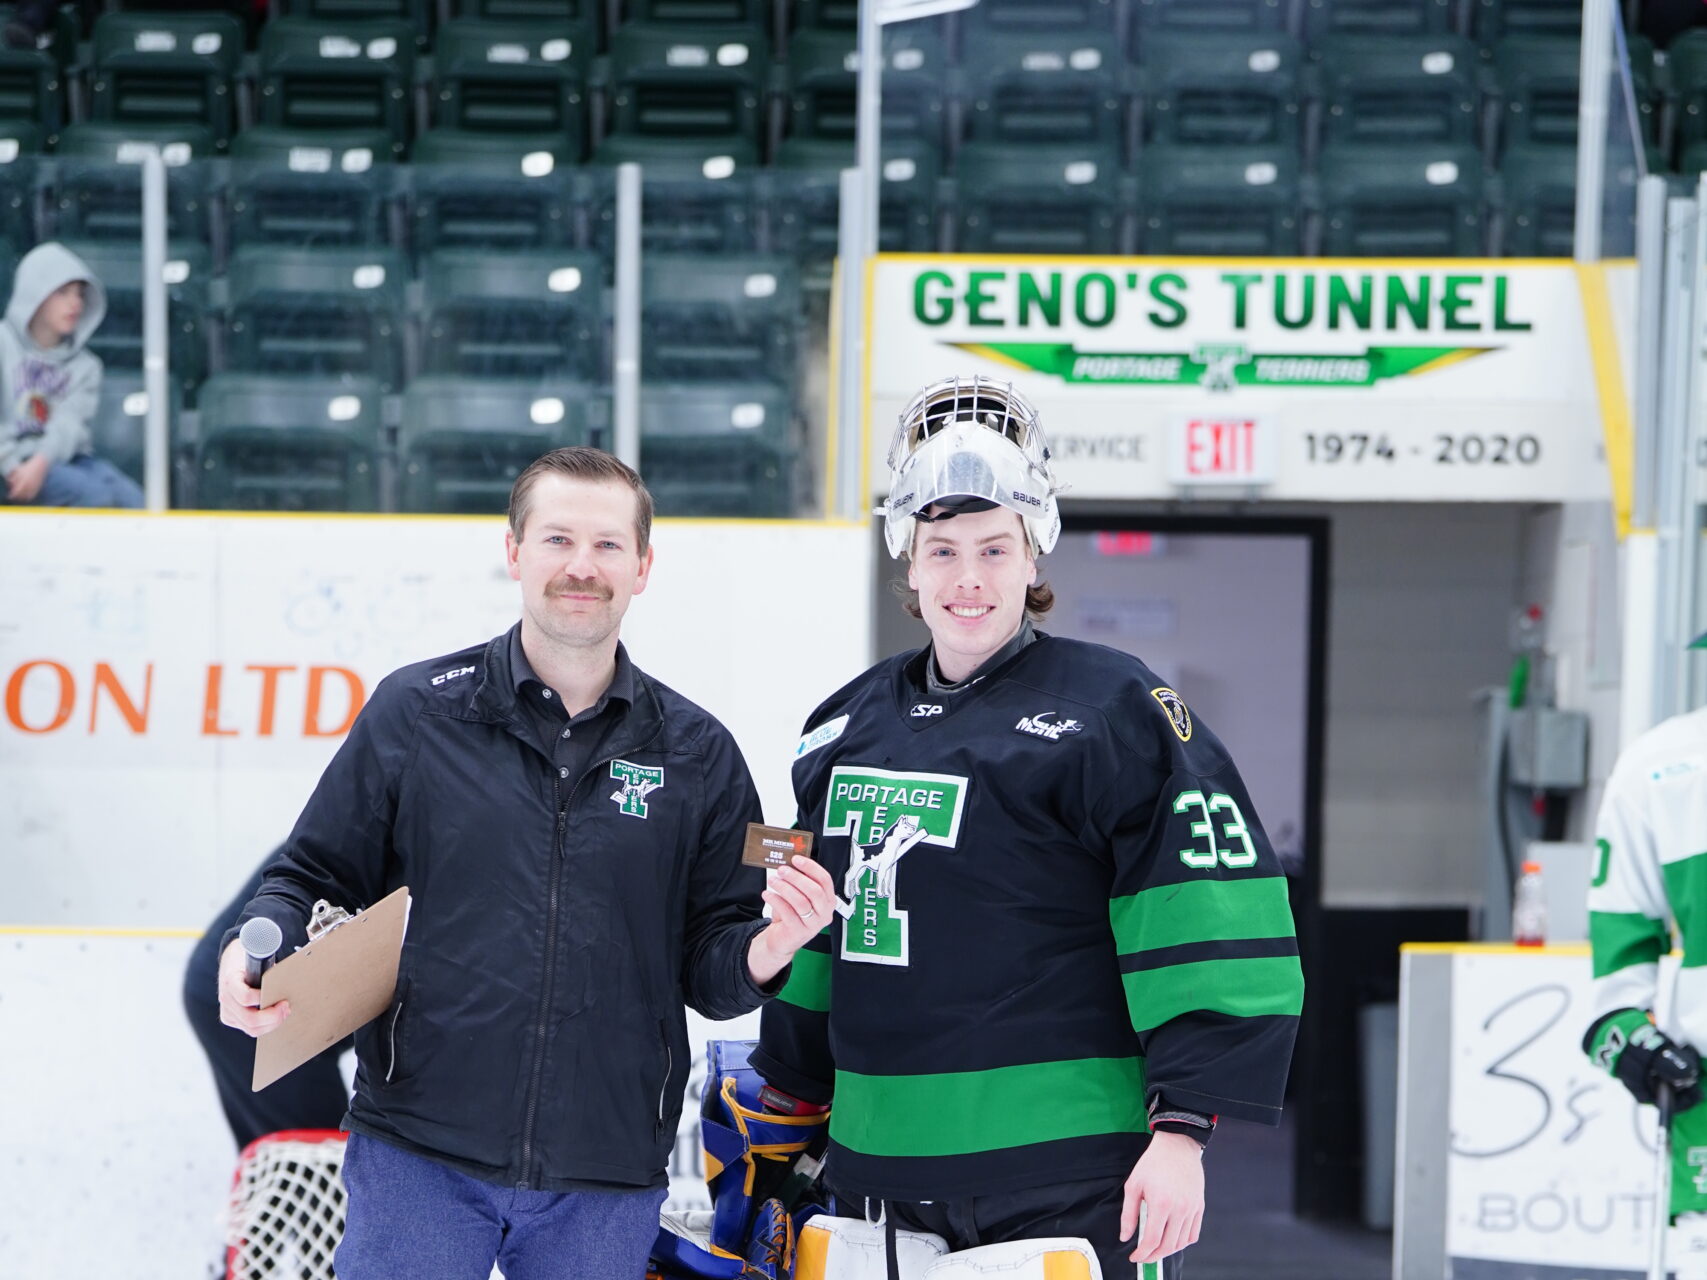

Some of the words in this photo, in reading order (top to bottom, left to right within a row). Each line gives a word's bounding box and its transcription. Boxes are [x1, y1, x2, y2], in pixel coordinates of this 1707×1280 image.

[913, 271, 1188, 328] GENO'S
[1220, 274, 1533, 331] TUNNEL
[1072, 356, 1183, 380] PORTAGE
[1254, 359, 1371, 383] TERRIERS
[1044, 433, 1146, 463] ERVICE
[1186, 420, 1255, 474] EXIT
[1305, 434, 1394, 464] 1974
[1435, 434, 1540, 465] 2020
[1013, 491, 1041, 508] BAUER
[431, 665, 476, 686] CCM
[5, 660, 154, 734] ON
[201, 664, 366, 737] LTD
[615, 763, 659, 778] PORTAGE
[836, 783, 944, 810] PORTAGE
[1173, 790, 1258, 869] 33
